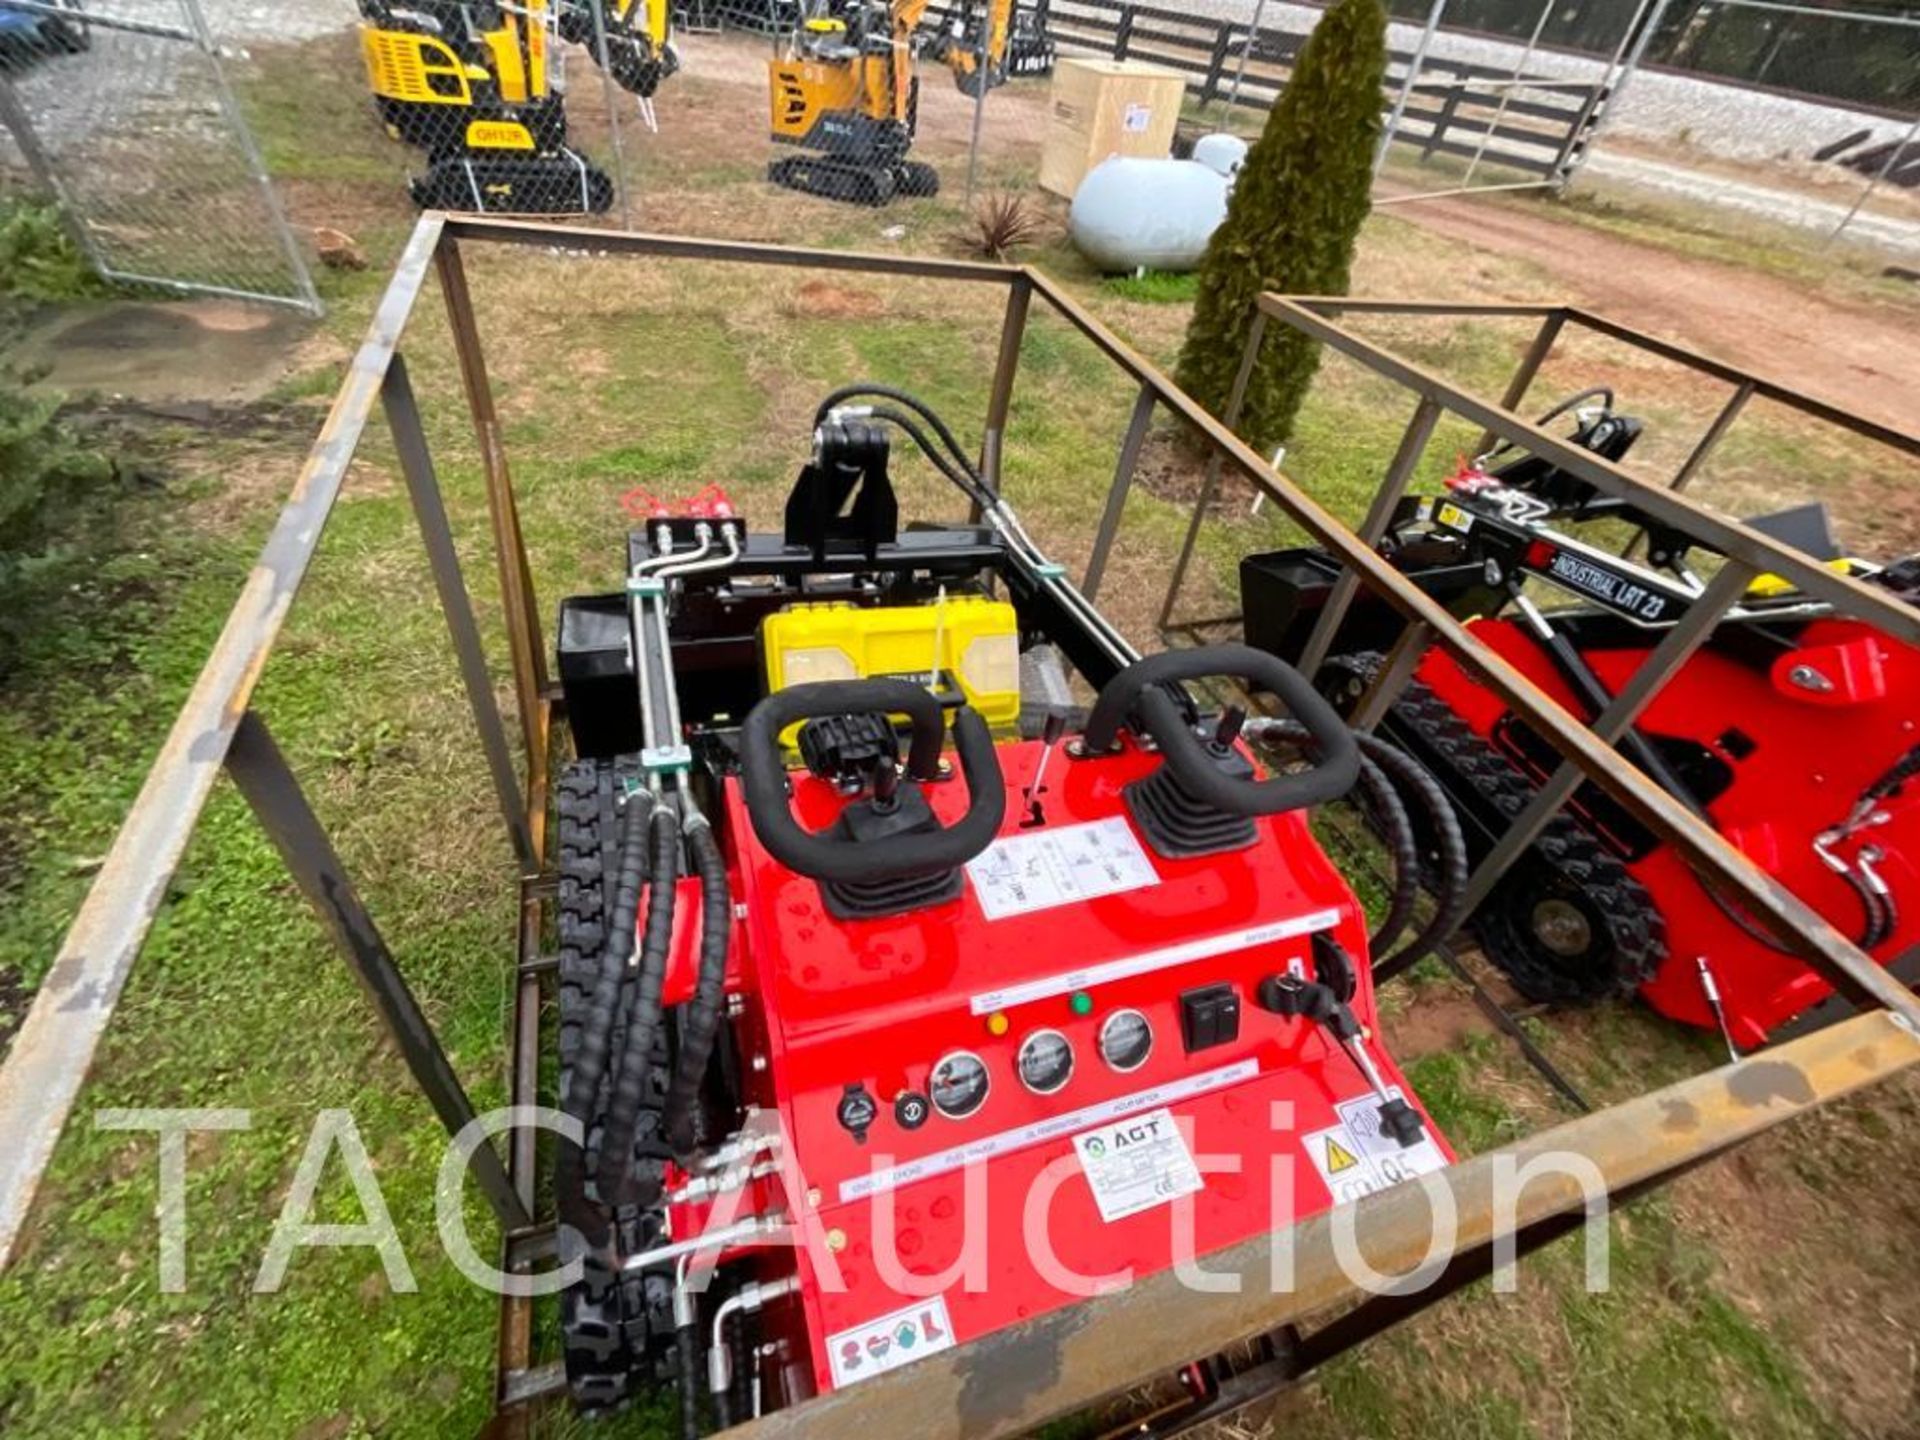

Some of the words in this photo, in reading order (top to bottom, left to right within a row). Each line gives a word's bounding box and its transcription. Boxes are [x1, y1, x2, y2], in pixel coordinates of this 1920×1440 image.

[1554, 555, 1618, 596] INDUSTRIAL
[1614, 581, 1648, 612] LRT
[1640, 596, 1667, 620] 23
[1114, 1121, 1160, 1148] AGT
